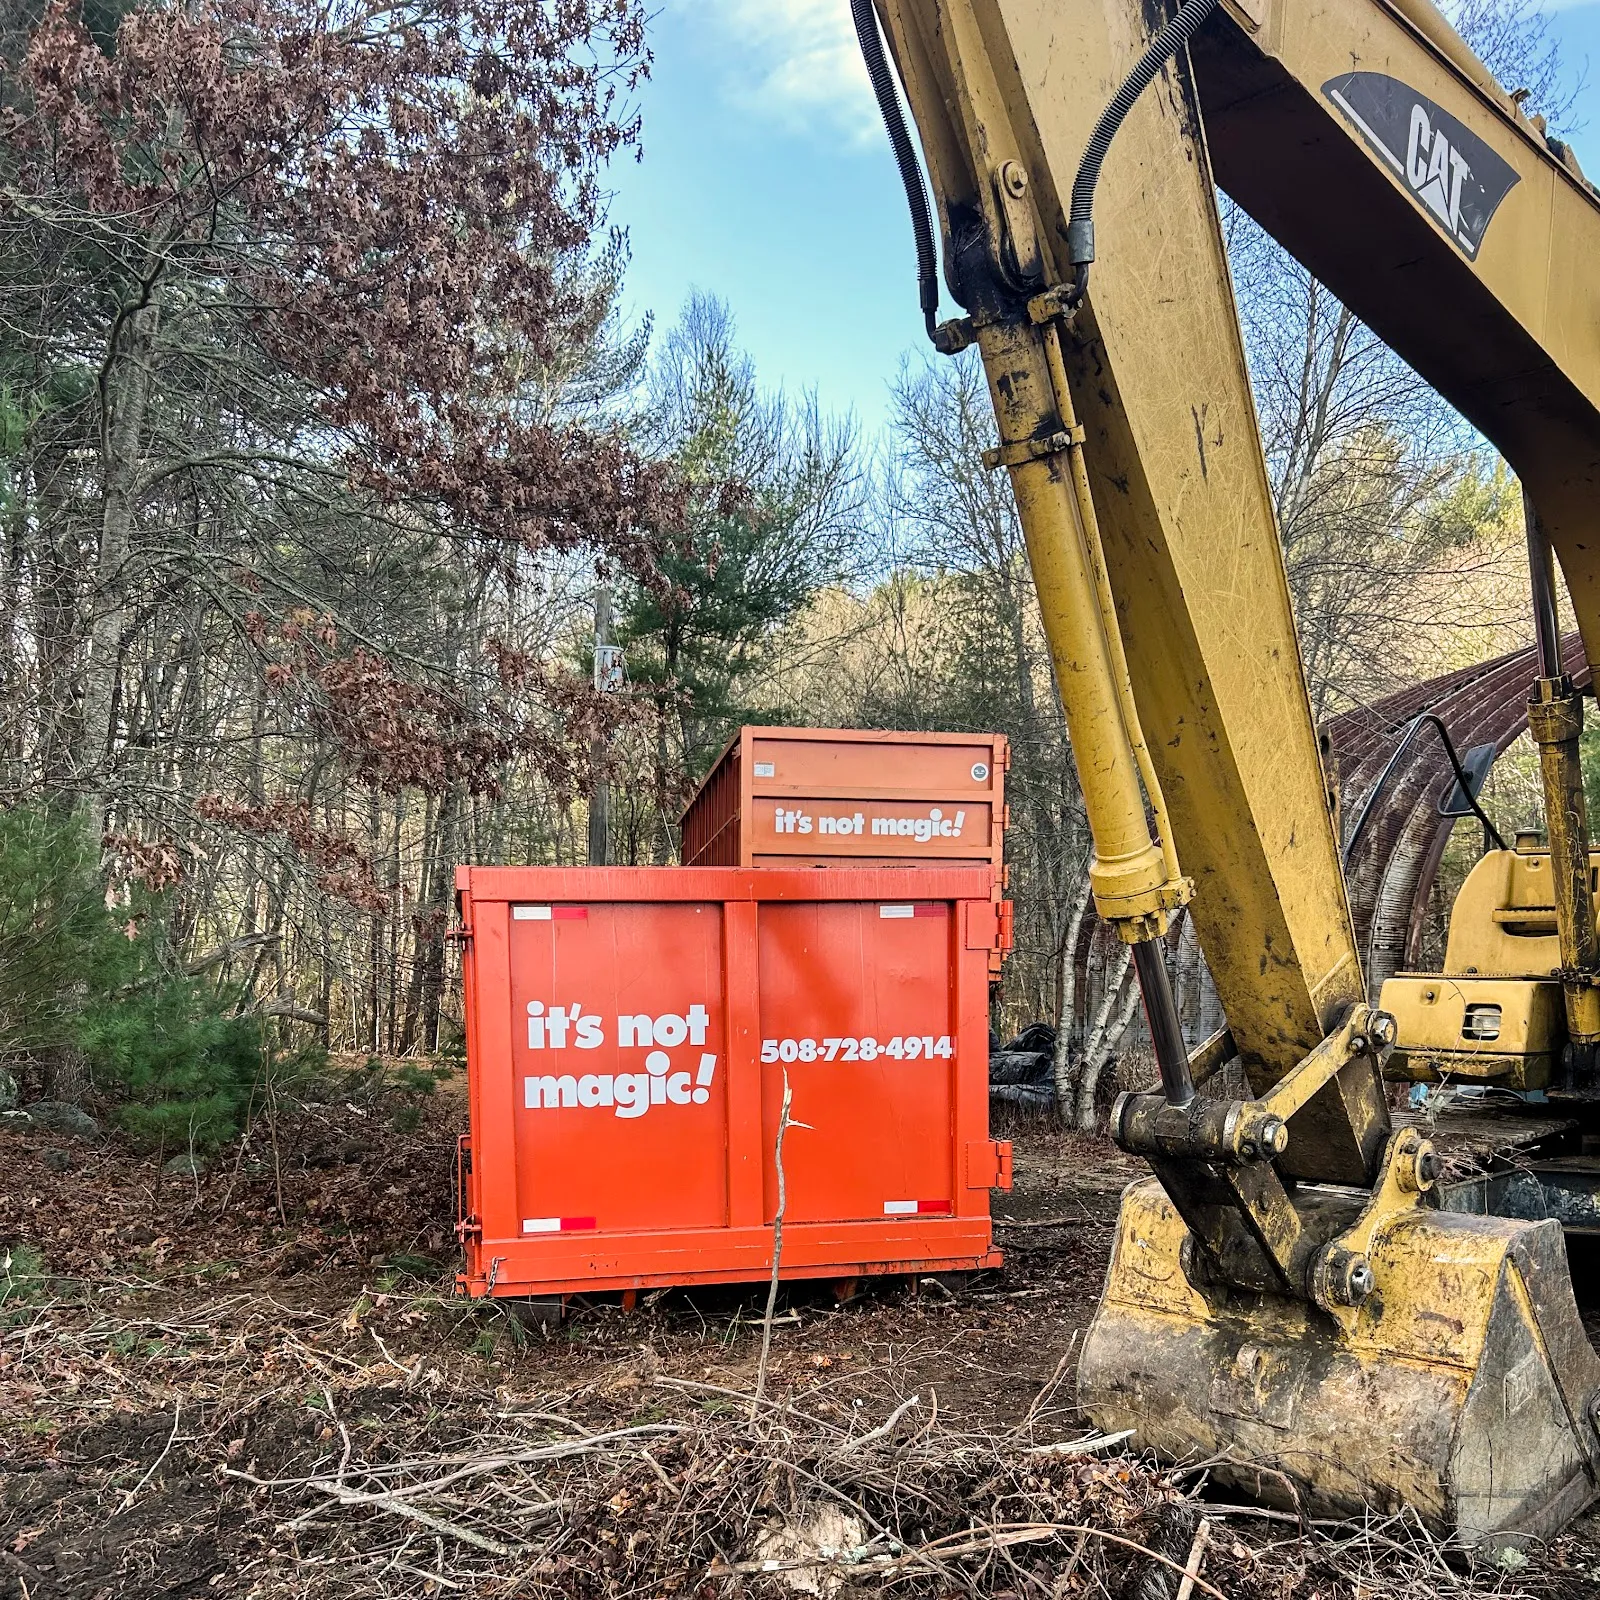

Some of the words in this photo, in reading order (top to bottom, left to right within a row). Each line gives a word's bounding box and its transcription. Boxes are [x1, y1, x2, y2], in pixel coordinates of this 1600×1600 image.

[1406, 103, 1470, 236] CAT
[775, 808, 813, 834] it's
[819, 813, 865, 835] not
[872, 808, 965, 843] magic!
[526, 1000, 605, 1049] it's
[618, 1004, 710, 1048] not
[524, 1051, 718, 1119] magic!
